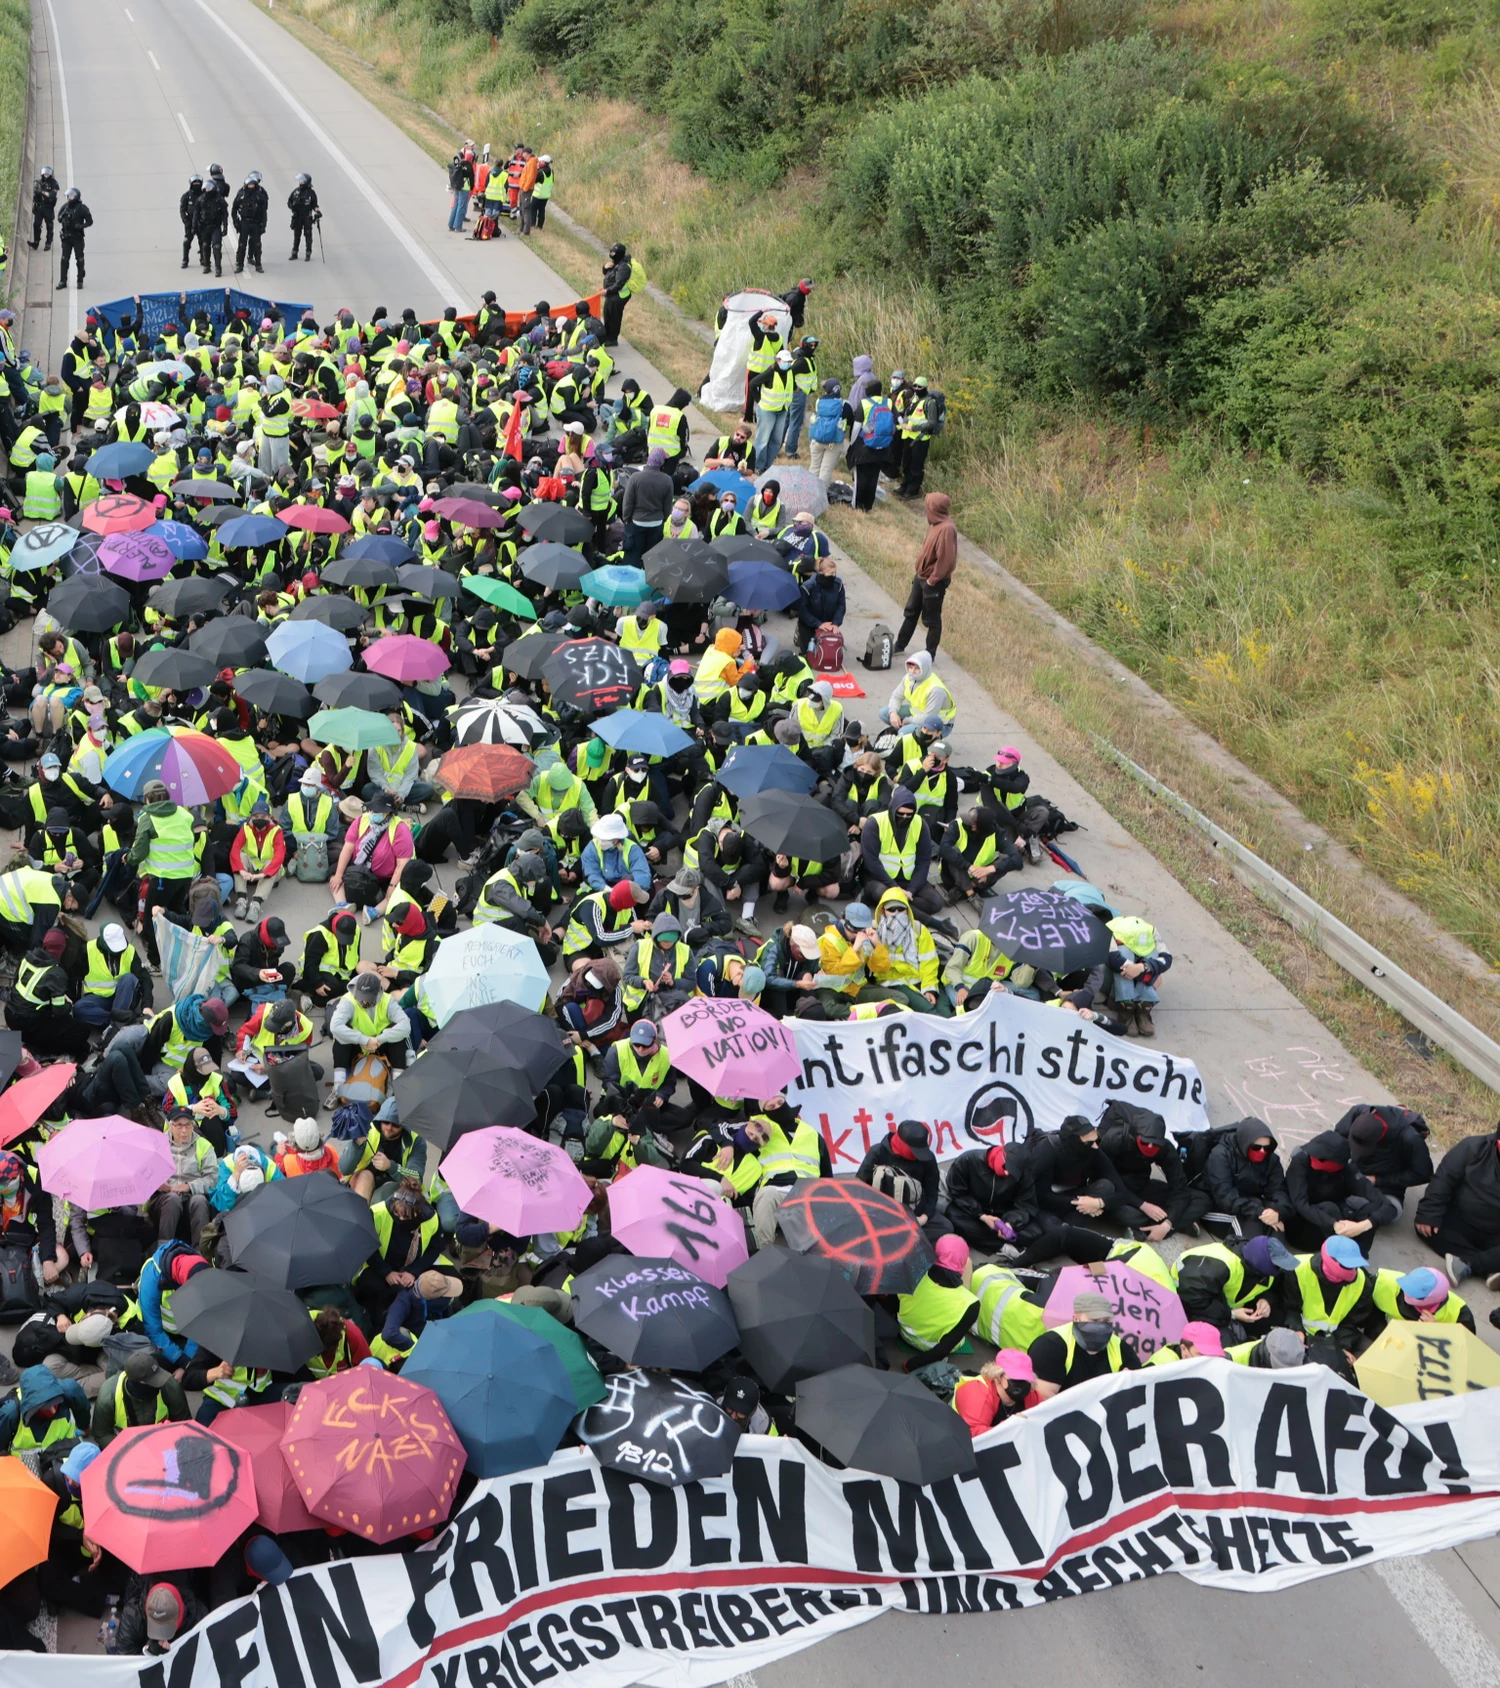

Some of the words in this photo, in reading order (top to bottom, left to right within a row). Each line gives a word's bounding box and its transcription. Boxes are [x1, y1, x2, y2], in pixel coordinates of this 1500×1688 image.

[563, 644, 623, 665] NZS
[881, 638, 891, 668] adidas
[571, 661, 629, 686] FCK
[989, 908, 1092, 951] ALERTA
[462, 953, 493, 971] EUCH
[464, 940, 524, 960] REMIGRIERT
[466, 976, 488, 992] INS
[717, 1016, 747, 1035] NO
[701, 1026, 791, 1069] NATION!
[662, 1181, 719, 1261] 161
[1111, 1297, 1160, 1330] den
[335, 1413, 439, 1485] NAZIS
[402, 1456, 809, 1649] FRIEDEN
[842, 1440, 1045, 1573] MIT
[1044, 1376, 1236, 1531] DER
[1255, 1382, 1470, 1497] AFD!
